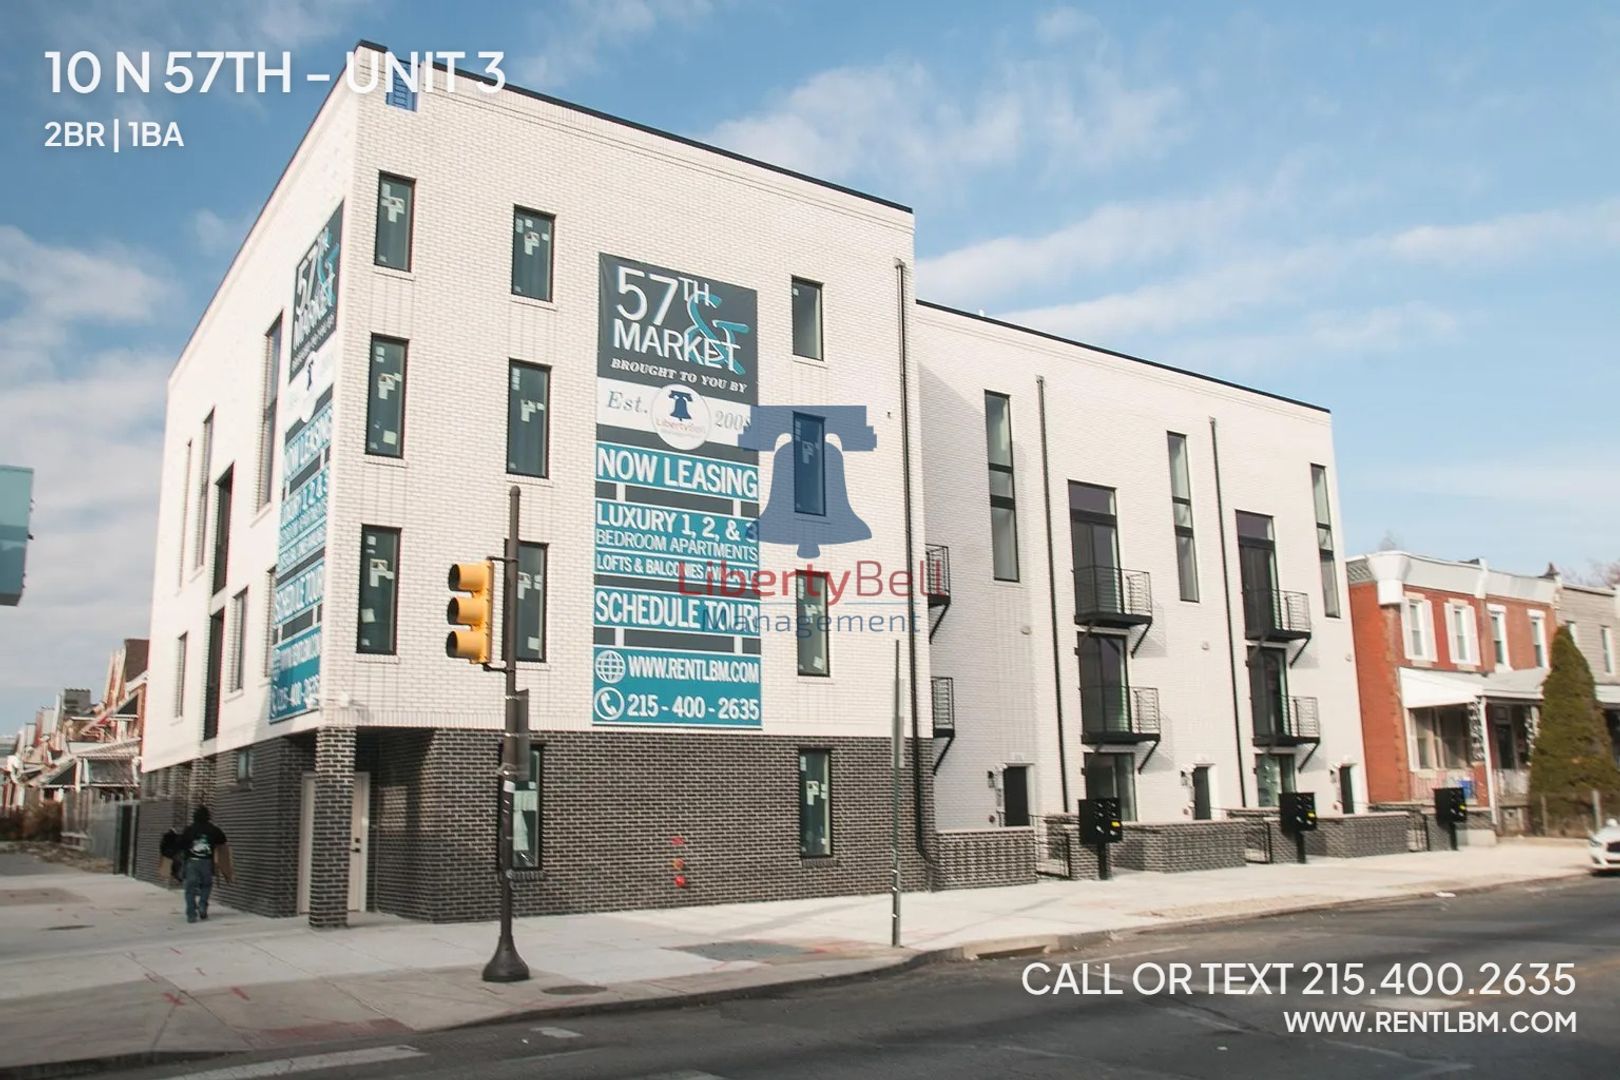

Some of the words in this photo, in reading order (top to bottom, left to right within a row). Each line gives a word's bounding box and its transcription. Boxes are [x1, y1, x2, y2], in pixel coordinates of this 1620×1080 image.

[616, 265, 718, 326] 57TH
[613, 318, 741, 373] MARKET
[610, 358, 676, 379] BROUGHT
[679, 371, 698, 384] TO
[701, 375, 728, 390] YOU
[729, 382, 748, 394] BY
[607, 390, 648, 414] Est.
[597, 447, 658, 484] NOW
[663, 456, 758, 498] LEASING
[596, 502, 677, 534] LUXURY
[681, 513, 697, 539] 1,
[701, 516, 720, 542] 2,
[725, 519, 741, 542] &
[596, 529, 667, 553] BEDROOM
[669, 536, 759, 562] APARTMENTS
[596, 553, 633, 572] LOFTS
[634, 557, 644, 574] &
[594, 590, 701, 629] SCHEDULE
[627, 654, 760, 684] WWW.RENTLBM.COM
[626, 693, 659, 718] 215
[671, 695, 706, 718] 400
[717, 697, 760, 721] 2635
